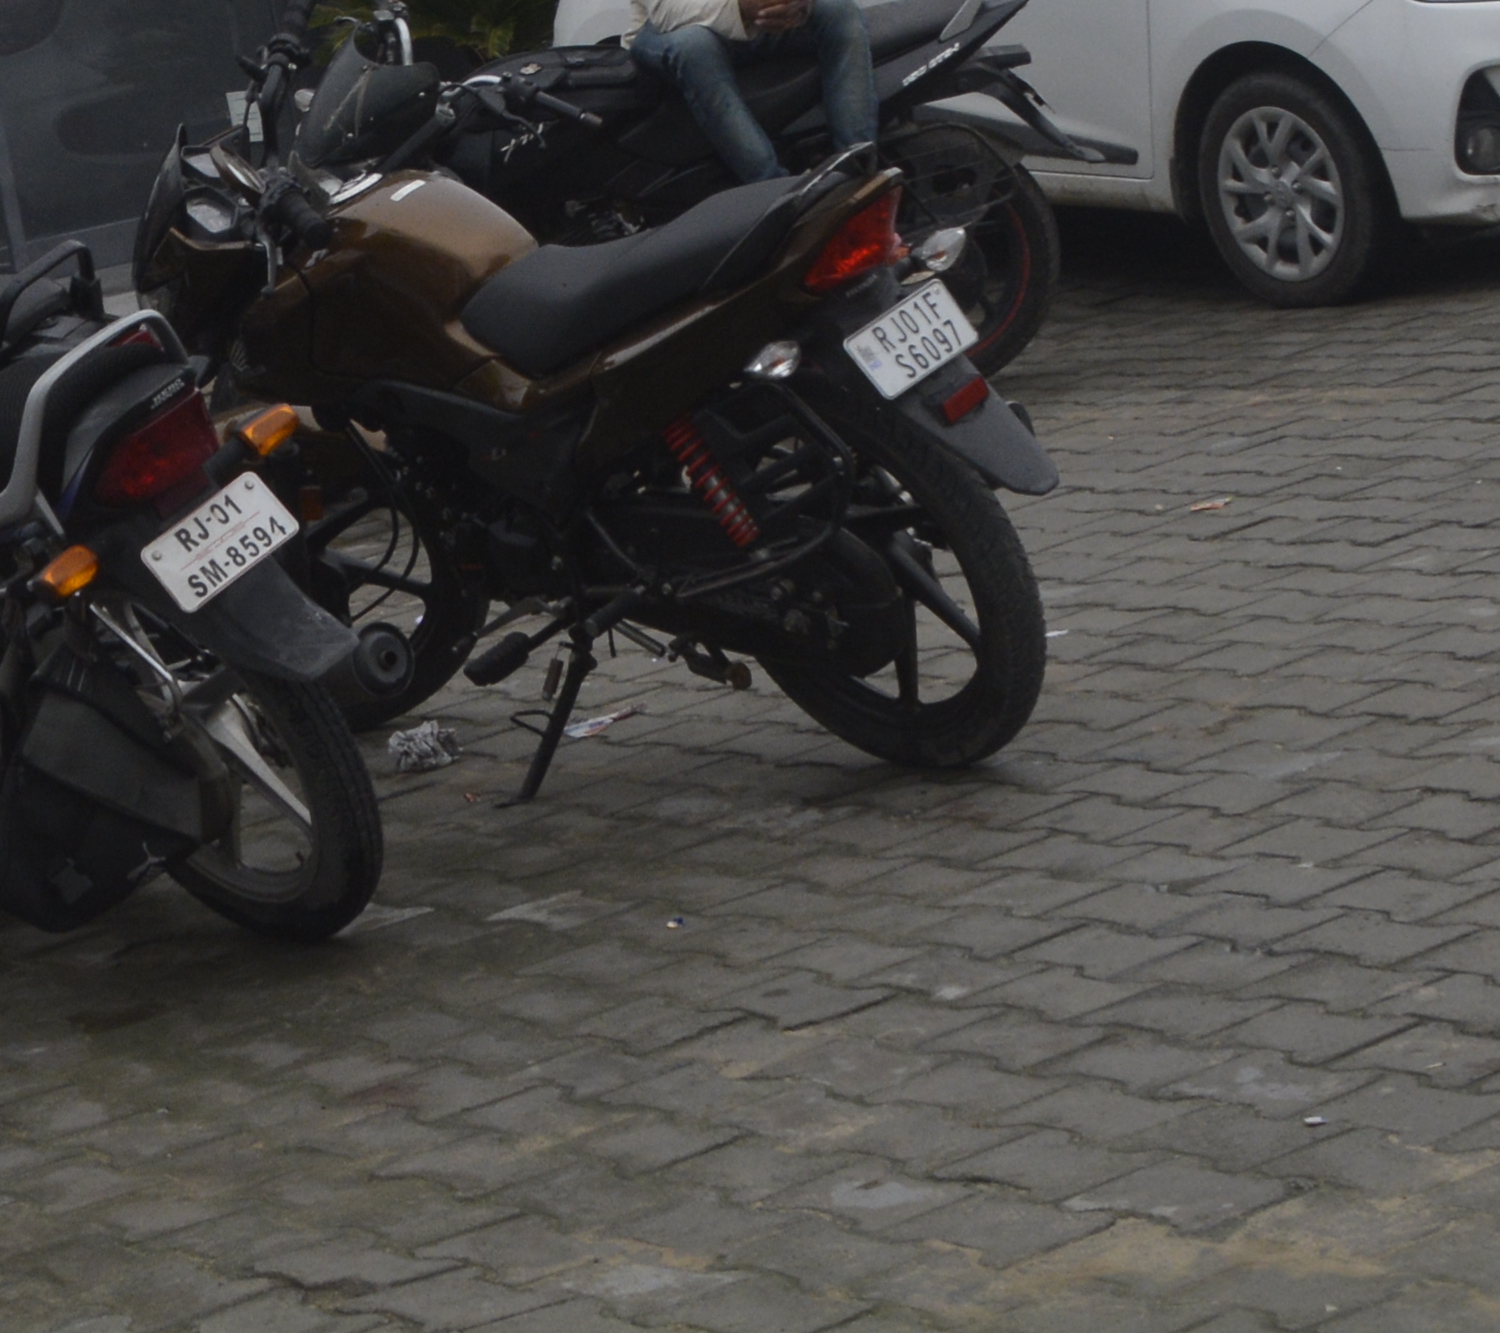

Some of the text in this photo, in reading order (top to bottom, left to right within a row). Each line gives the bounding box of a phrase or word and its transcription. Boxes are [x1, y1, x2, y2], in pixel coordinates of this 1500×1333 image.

[872, 292, 940, 353] RJ01F
[895, 319, 962, 378] S6097
[174, 494, 243, 552] RJ-01
